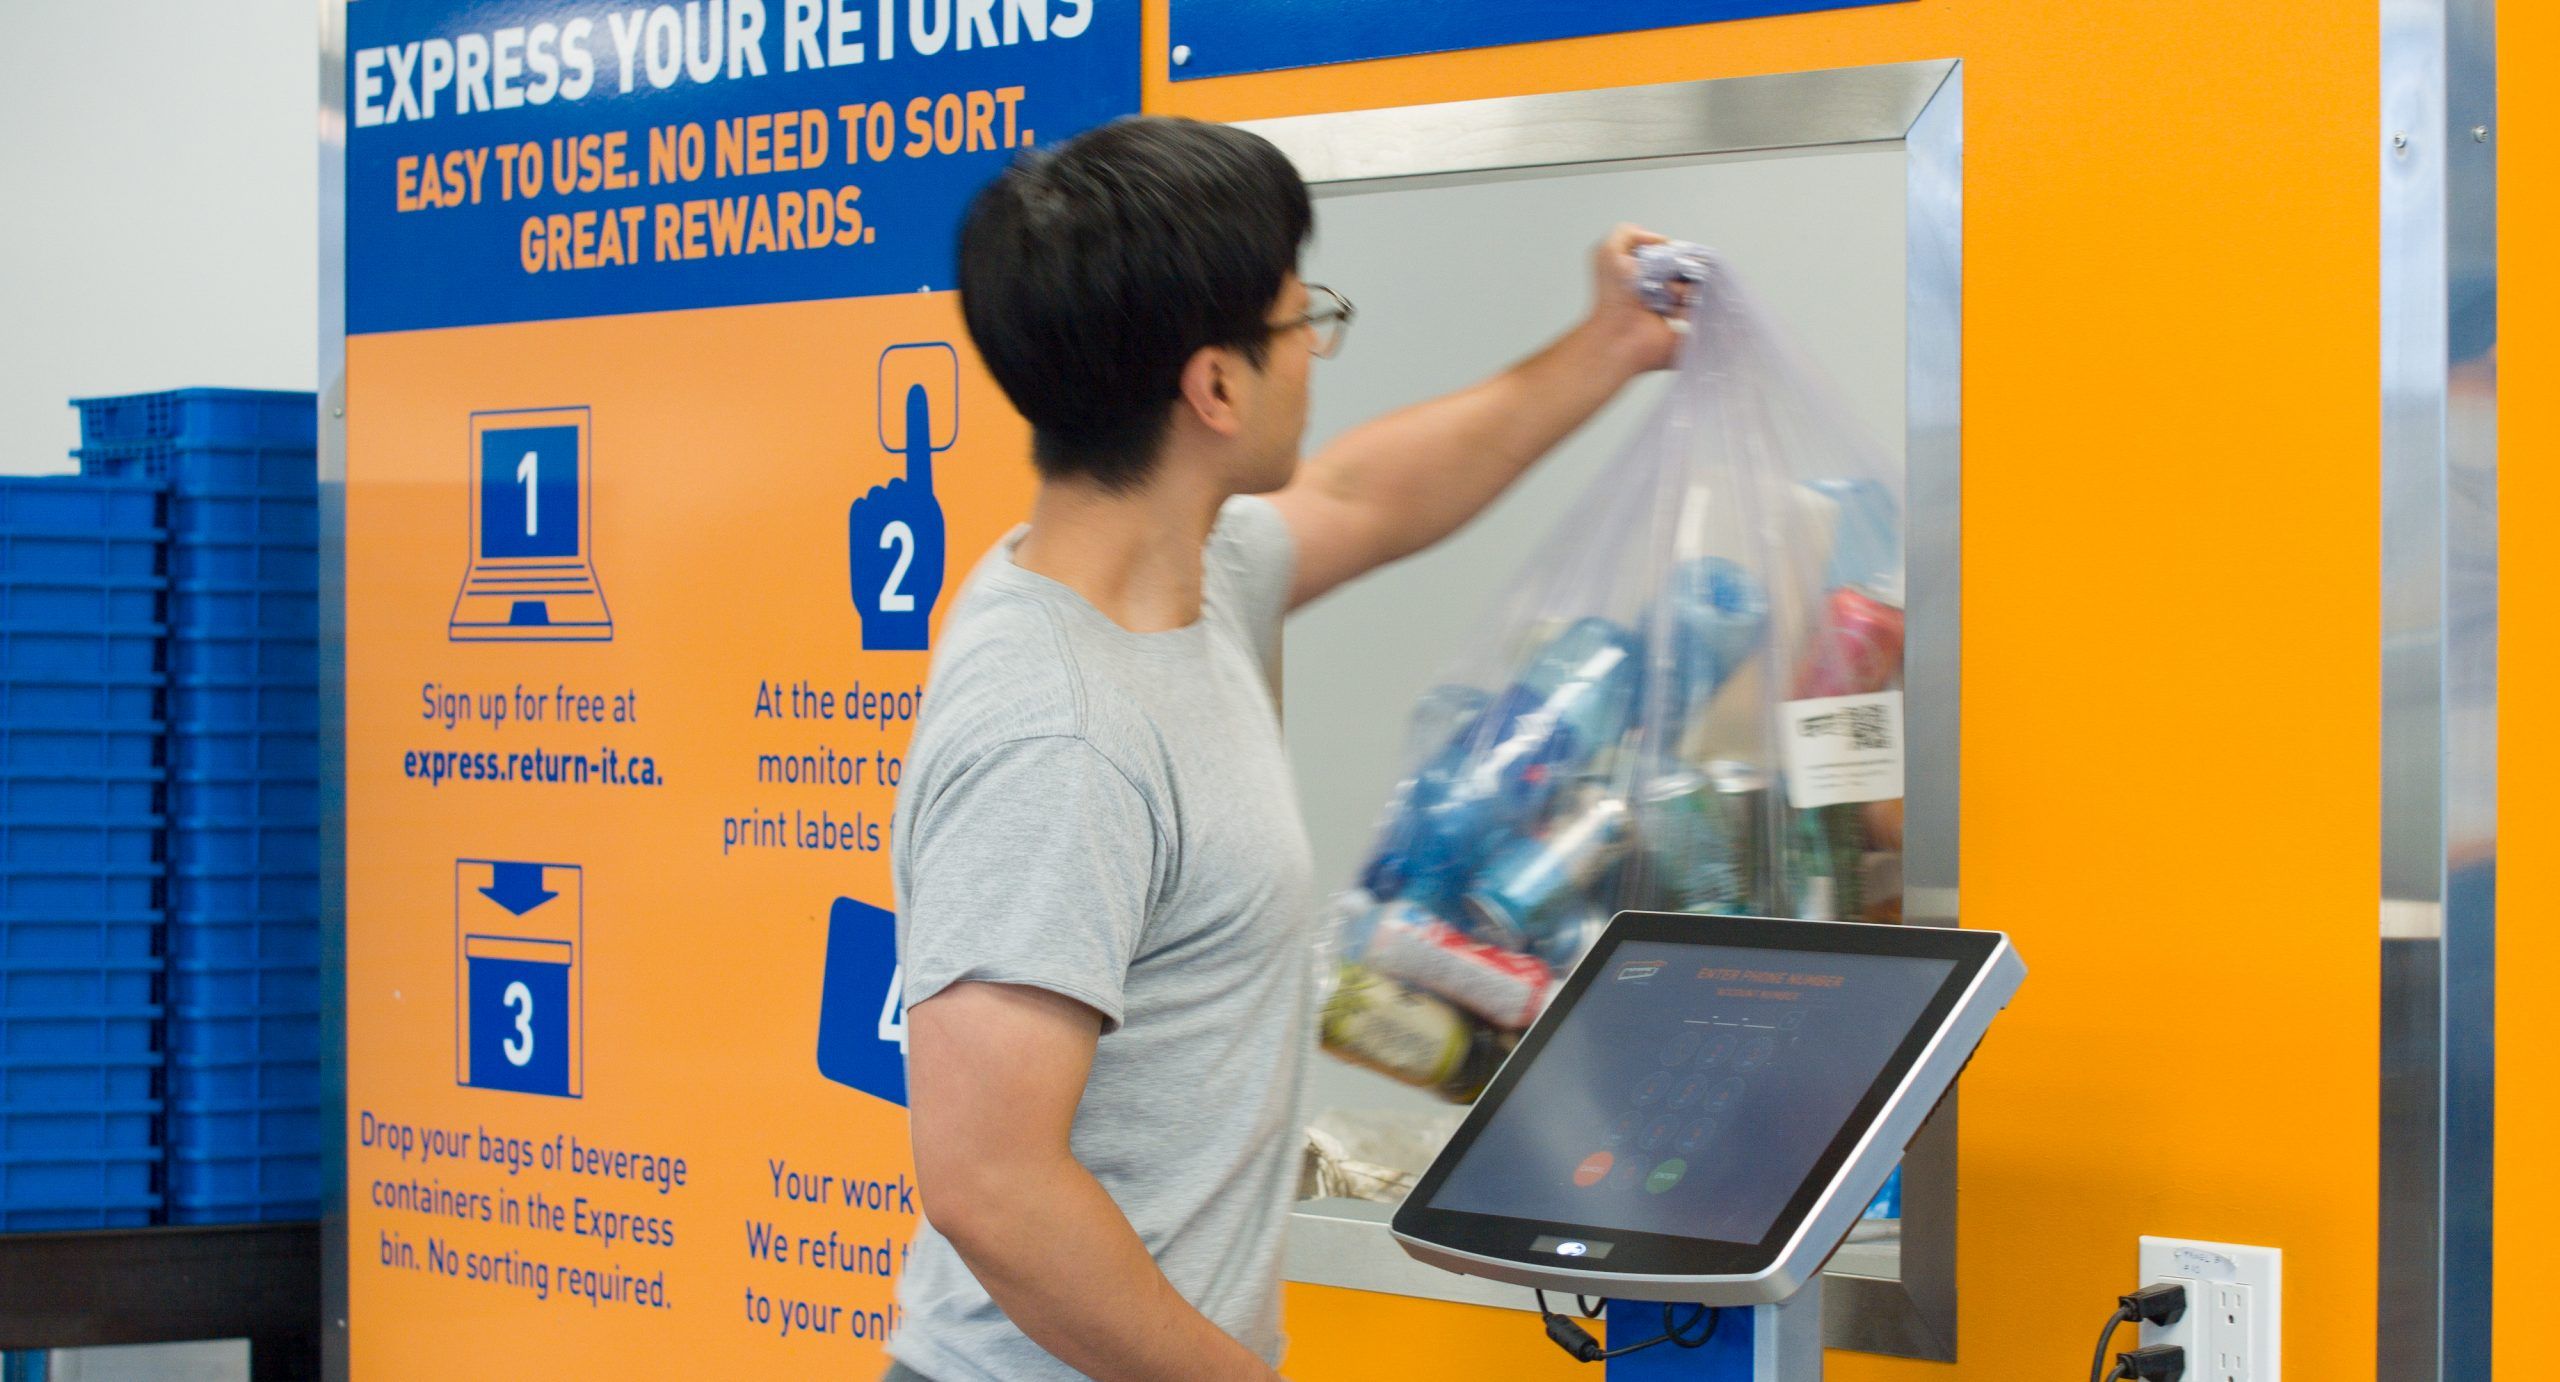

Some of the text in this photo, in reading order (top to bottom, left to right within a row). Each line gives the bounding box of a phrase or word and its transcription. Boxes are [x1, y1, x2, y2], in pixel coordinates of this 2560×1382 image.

[355, 18, 595, 127] EXPRESS
[608, 0, 767, 93] YOUR
[397, 86, 1034, 211] EASY TO USE. NO NEED TO SORT.
[521, 187, 875, 273] GREAT REWARDS.
[516, 451, 537, 536] 1
[879, 520, 914, 612] 2
[422, 682, 636, 731] Sign up for free at
[754, 680, 923, 731] At the depot
[404, 745, 663, 787] express.return-it.ca.
[758, 745, 902, 787] monitor to
[723, 808, 787, 855] print
[797, 810, 881, 853] labels
[503, 981, 533, 1066] 3
[878, 964, 908, 1054] 4
[360, 1110, 687, 1192] Drop your bags of beverage
[769, 1159, 914, 1215] Your work
[372, 1177, 674, 1248] containers in the Express
[745, 1219, 788, 1264] We
[798, 1231, 891, 1277] refund
[380, 1230, 672, 1309] bin. No sorting required.
[745, 1287, 771, 1325] to
[780, 1300, 843, 1338] your
